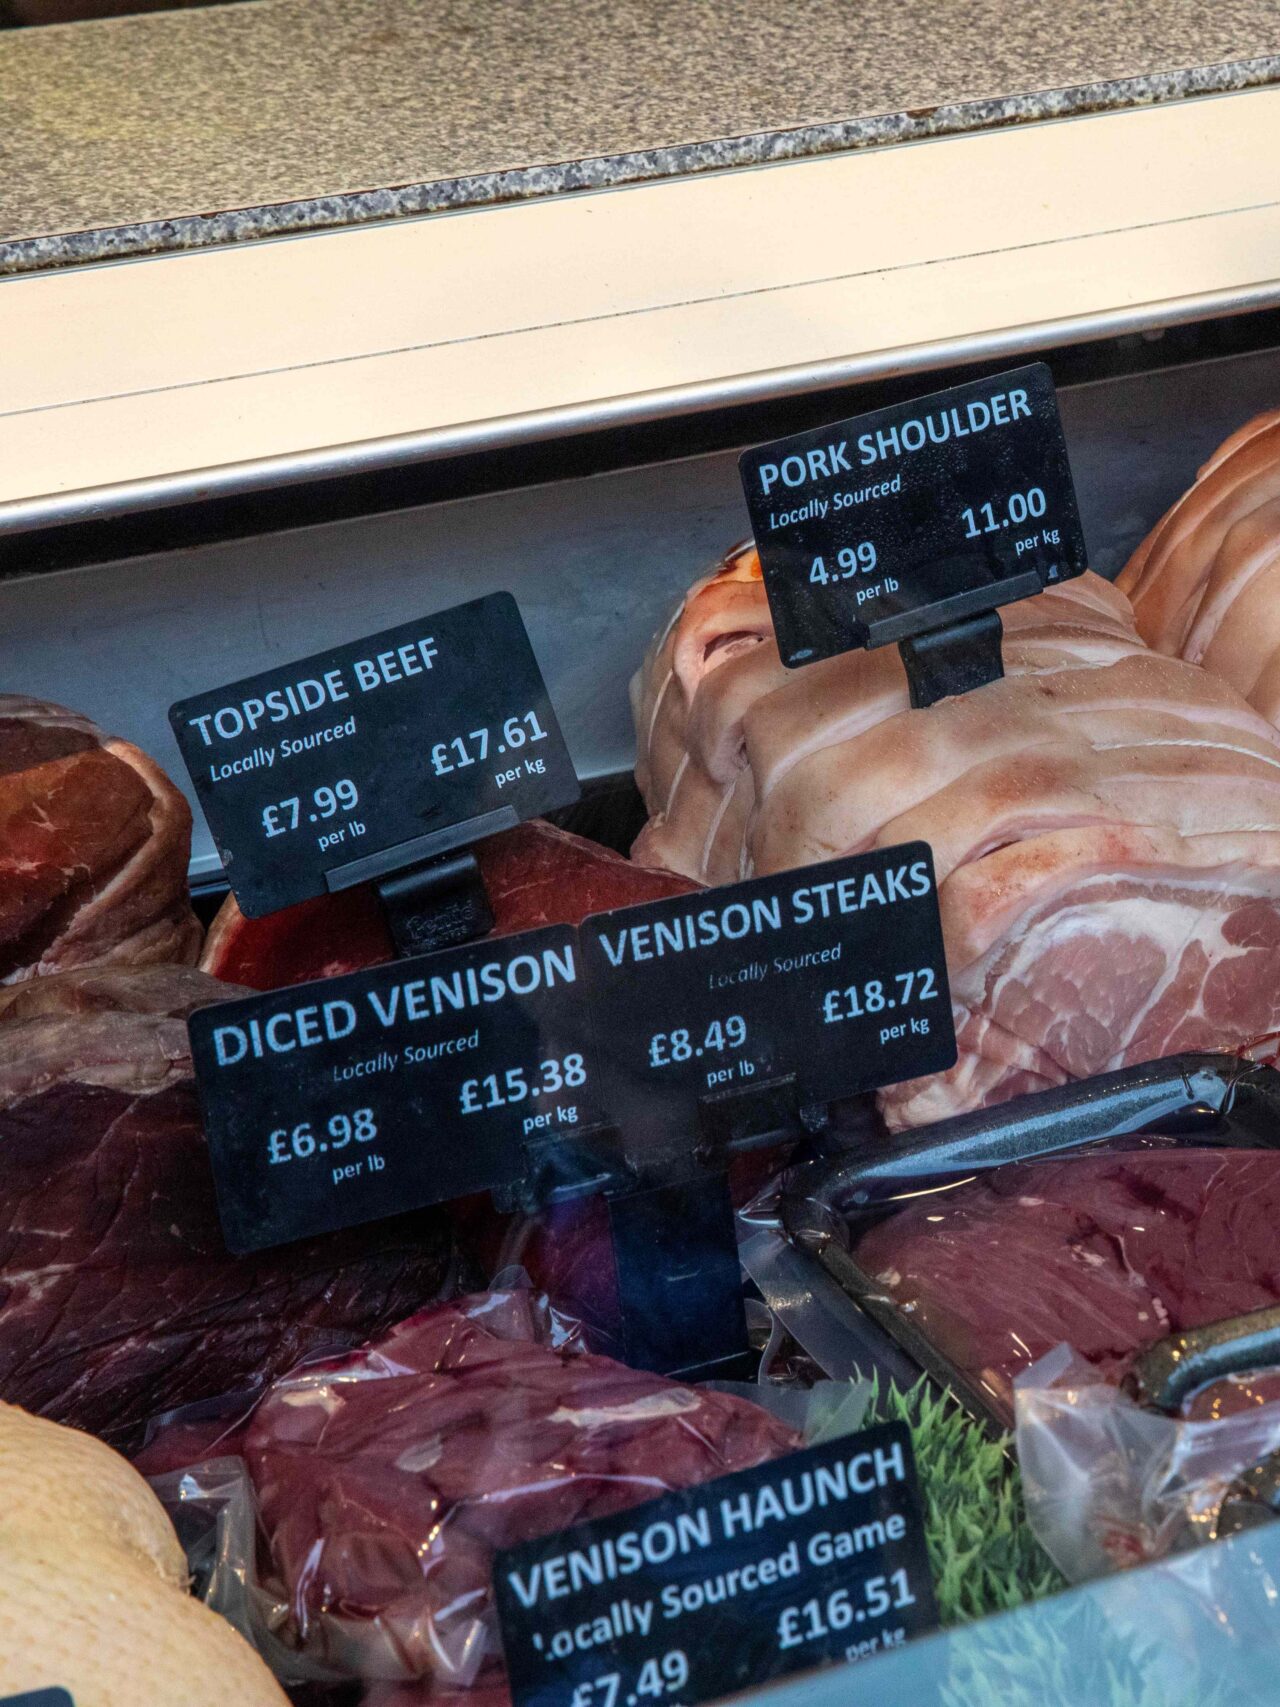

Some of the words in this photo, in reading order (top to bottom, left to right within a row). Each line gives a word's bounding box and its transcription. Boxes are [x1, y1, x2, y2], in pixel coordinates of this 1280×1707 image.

[759, 441, 852, 495] PORK
[858, 389, 1033, 465] SHOULDER
[770, 496, 829, 530] Locally
[832, 473, 902, 511] Sourced
[809, 541, 878, 587] 4.99
[962, 487, 1047, 539] 11.00
[856, 586, 882, 605] per
[884, 576, 900, 593] lb
[1015, 536, 1040, 556] per
[1042, 528, 1060, 546] kg
[189, 669, 350, 747] TOPSIDE
[353, 637, 439, 692] BEEF
[210, 745, 276, 782] Locally
[280, 716, 358, 757] Sourced
[262, 778, 359, 839] £7.99
[430, 710, 548, 776] £17.61
[317, 829, 348, 852] per
[349, 819, 367, 838] lb
[494, 768, 524, 789] per
[525, 757, 546, 780] kg
[599, 895, 783, 968] VENISON
[792, 860, 932, 925] STEAKS
[212, 999, 358, 1067] DICED
[367, 944, 577, 1028] VENISON
[708, 962, 768, 990] Locally
[773, 942, 842, 977] Sourced
[332, 1051, 399, 1083] Locally
[403, 1029, 480, 1065] Sourced
[648, 1014, 748, 1069] £8.49
[822, 967, 939, 1024] £18.72
[706, 1068, 735, 1088] per
[738, 1059, 755, 1077] lb
[879, 1022, 907, 1044] per
[910, 1015, 930, 1035] kg
[267, 1107, 379, 1166] £6.98
[459, 1052, 588, 1115] £15.38
[332, 1164, 362, 1185] per
[367, 1153, 386, 1174] lb
[522, 1111, 553, 1135] per
[557, 1105, 579, 1127] kg
[508, 1507, 711, 1610] VENISON
[720, 1441, 907, 1539] HAUNCH
[661, 1541, 800, 1619] Sourced
[807, 1513, 907, 1567] Game
[570, 1650, 689, 1707] £7.49
[777, 1567, 917, 1650] £16.51
[845, 1637, 879, 1664] per
[882, 1627, 907, 1648] kg
